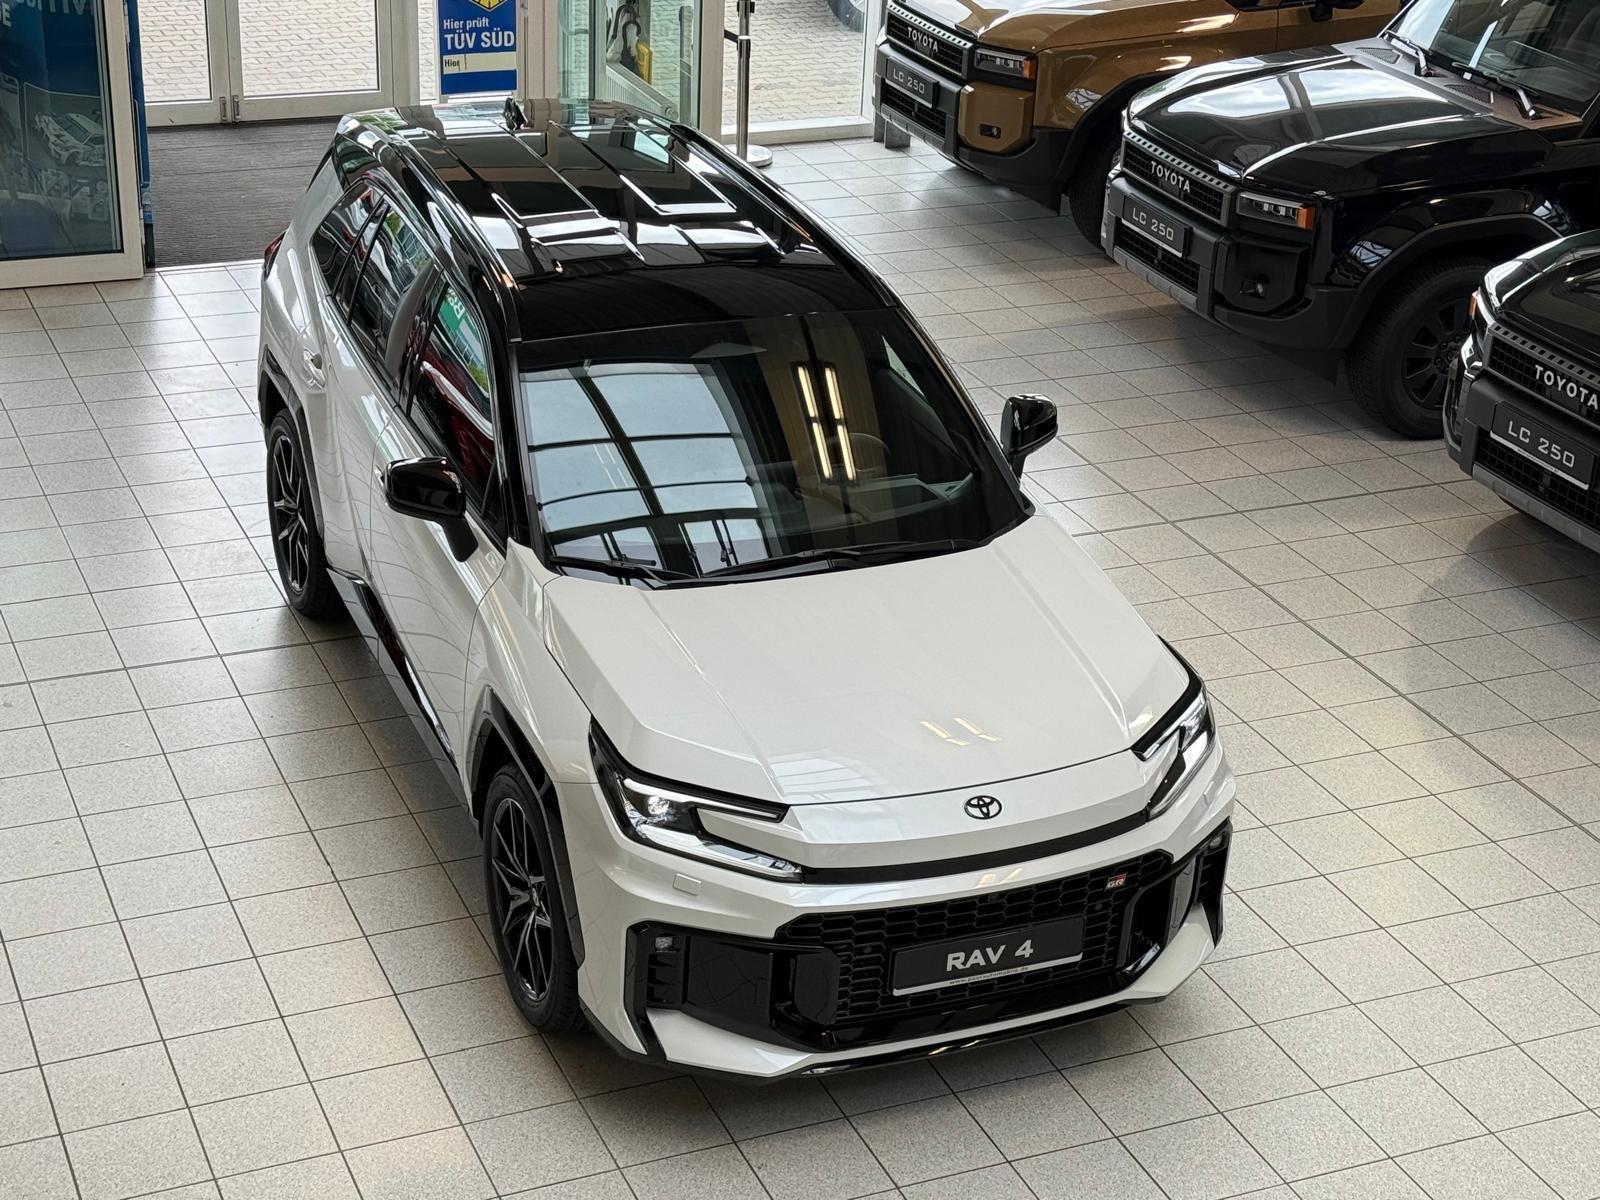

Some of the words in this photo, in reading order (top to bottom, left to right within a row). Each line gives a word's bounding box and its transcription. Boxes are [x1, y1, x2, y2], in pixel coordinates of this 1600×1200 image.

[443, 18, 464, 30] Hier
[466, 16, 490, 31] prüft
[443, 29, 476, 50] TÜV
[480, 27, 515, 48] SÜD
[907, 26, 939, 53] TOYOTA
[893, 67, 904, 83] LC
[907, 77, 925, 94] 250
[1150, 161, 1191, 194] TOYOTA
[1132, 208, 1147, 225] LC
[1151, 219, 1174, 241] 250
[1534, 364, 1599, 410] TOYOTA
[1507, 420, 1531, 444] LC
[1537, 437, 1575, 468] 250
[1105, 878, 1125, 890] GR
[946, 944, 1006, 972] RAV
[1014, 939, 1034, 959] 4
